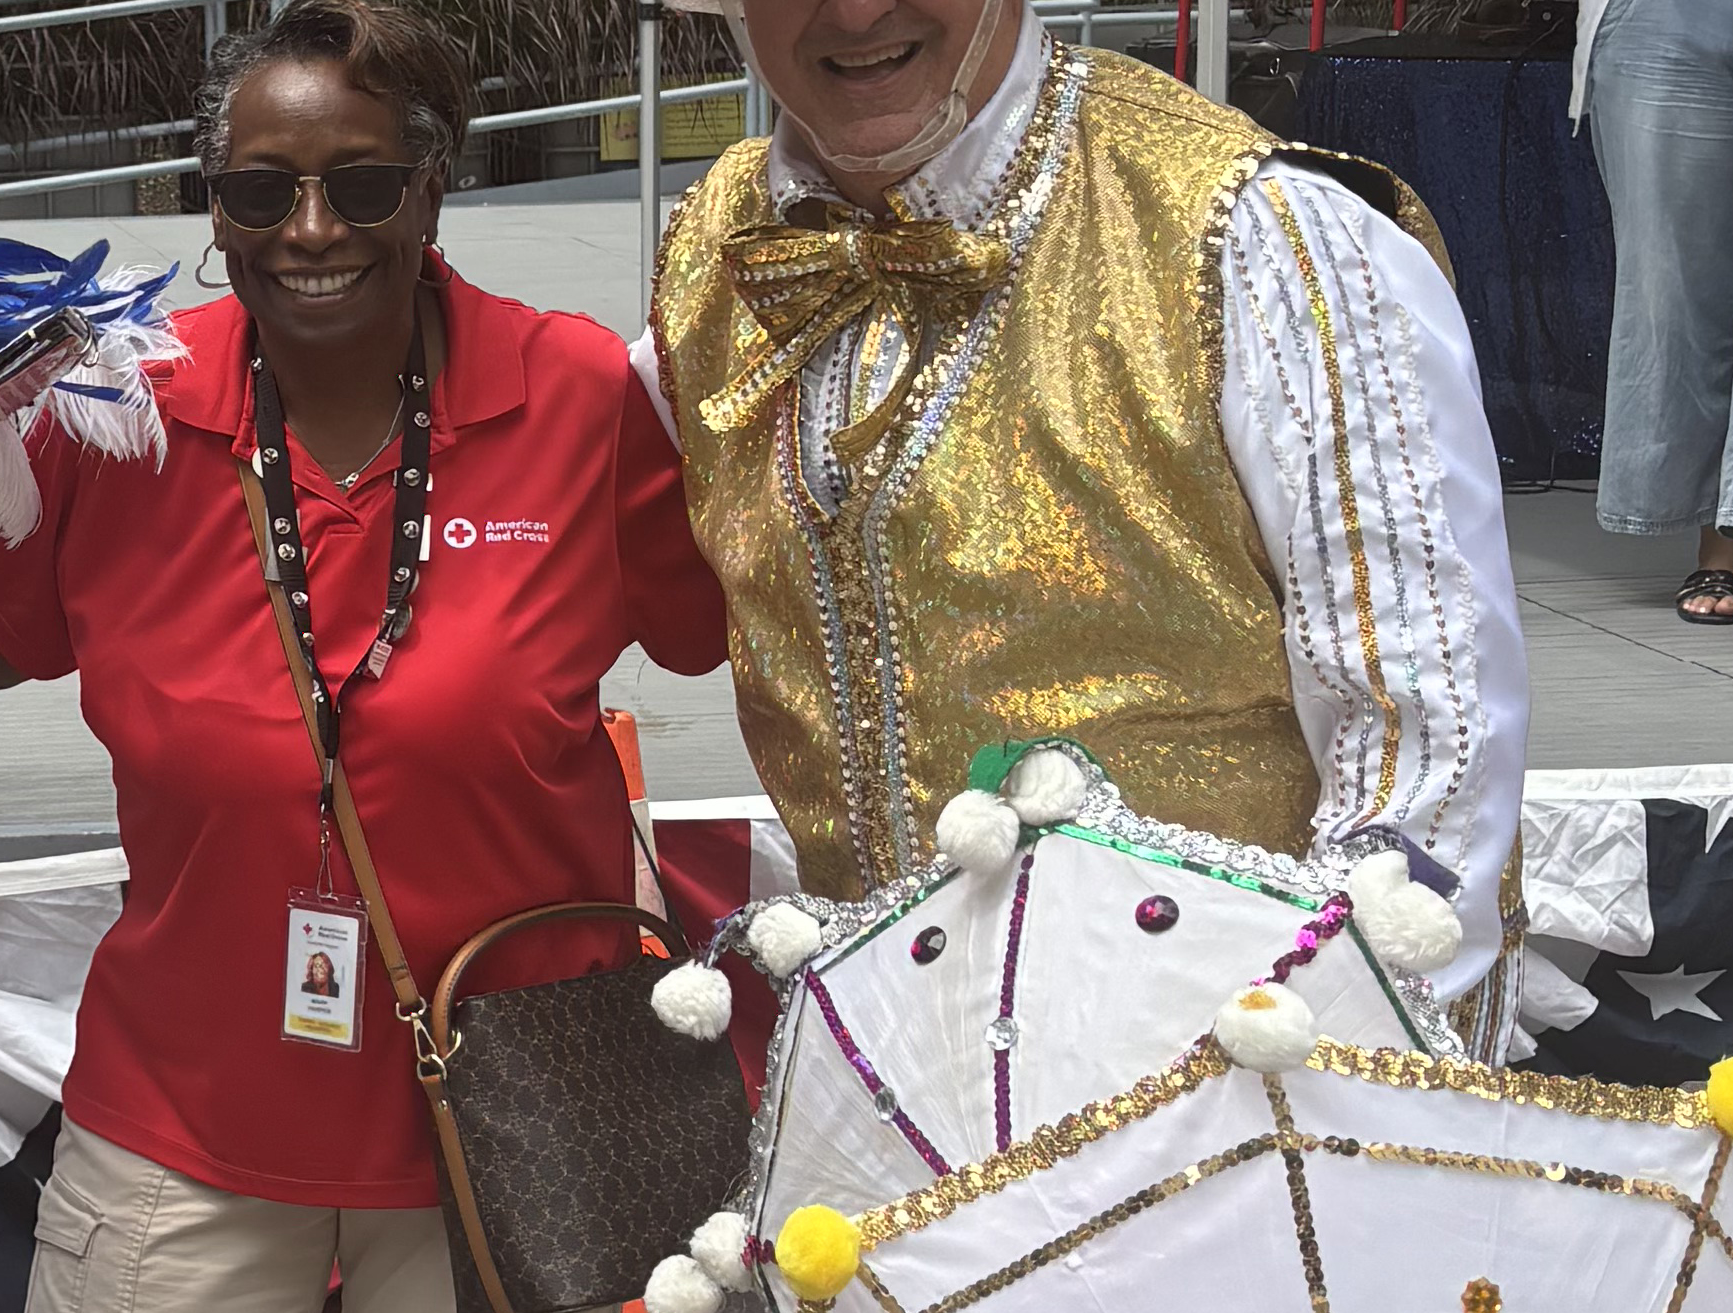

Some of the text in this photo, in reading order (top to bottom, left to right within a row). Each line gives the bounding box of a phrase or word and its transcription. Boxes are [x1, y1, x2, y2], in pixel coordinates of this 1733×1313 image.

[485, 518, 549, 532] American
[485, 529, 550, 543] Red Cross
